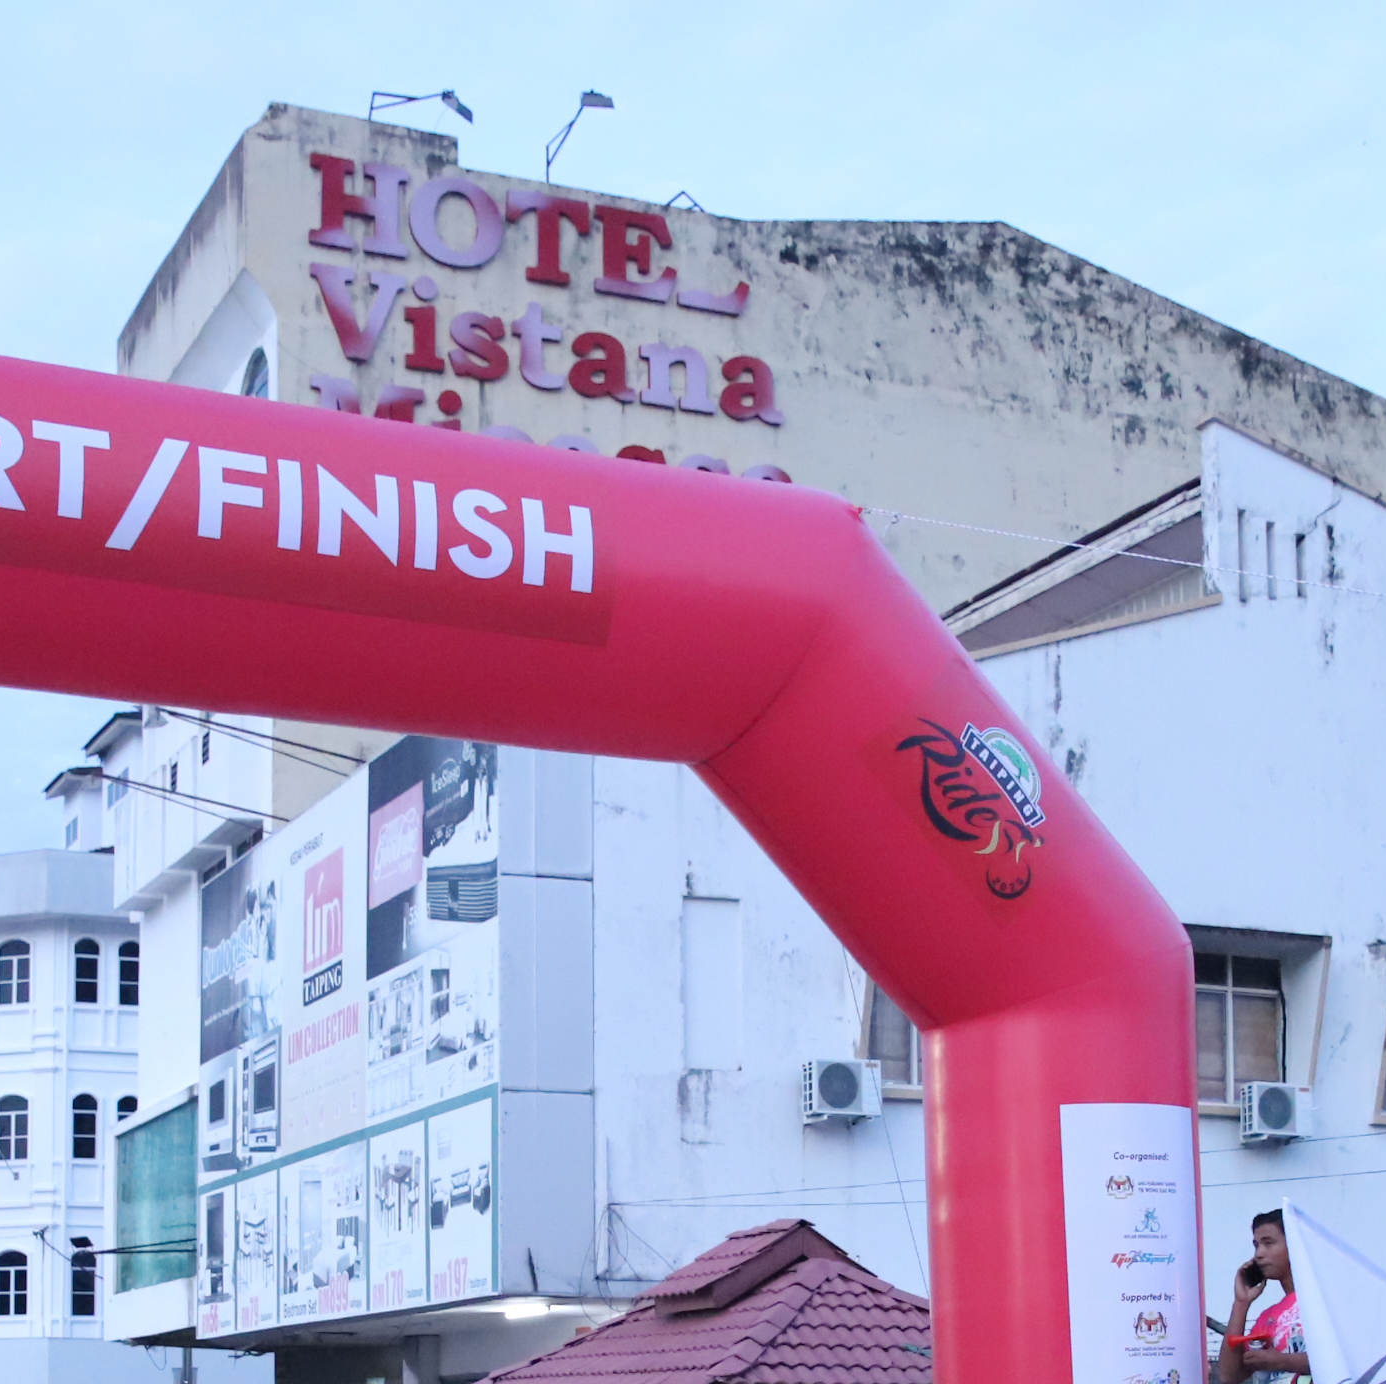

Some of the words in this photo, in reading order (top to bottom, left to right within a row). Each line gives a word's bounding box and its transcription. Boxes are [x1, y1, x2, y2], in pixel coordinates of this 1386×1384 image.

[309, 263, 785, 427] Vistana
[896, 717, 1001, 841] Ride
[970, 736, 1034, 818] TAIPING
[303, 964, 342, 1003] TAIPING
[288, 1029, 303, 1065] LIM
[304, 1001, 359, 1058] COLLECTION
[1113, 1151, 1169, 1162] Co-organised:
[283, 1302, 307, 1318] Bedroom
[308, 1299, 318, 1315] Set
[1121, 1293, 1162, 1303] Supported
[1164, 1293, 1175, 1303] by:
